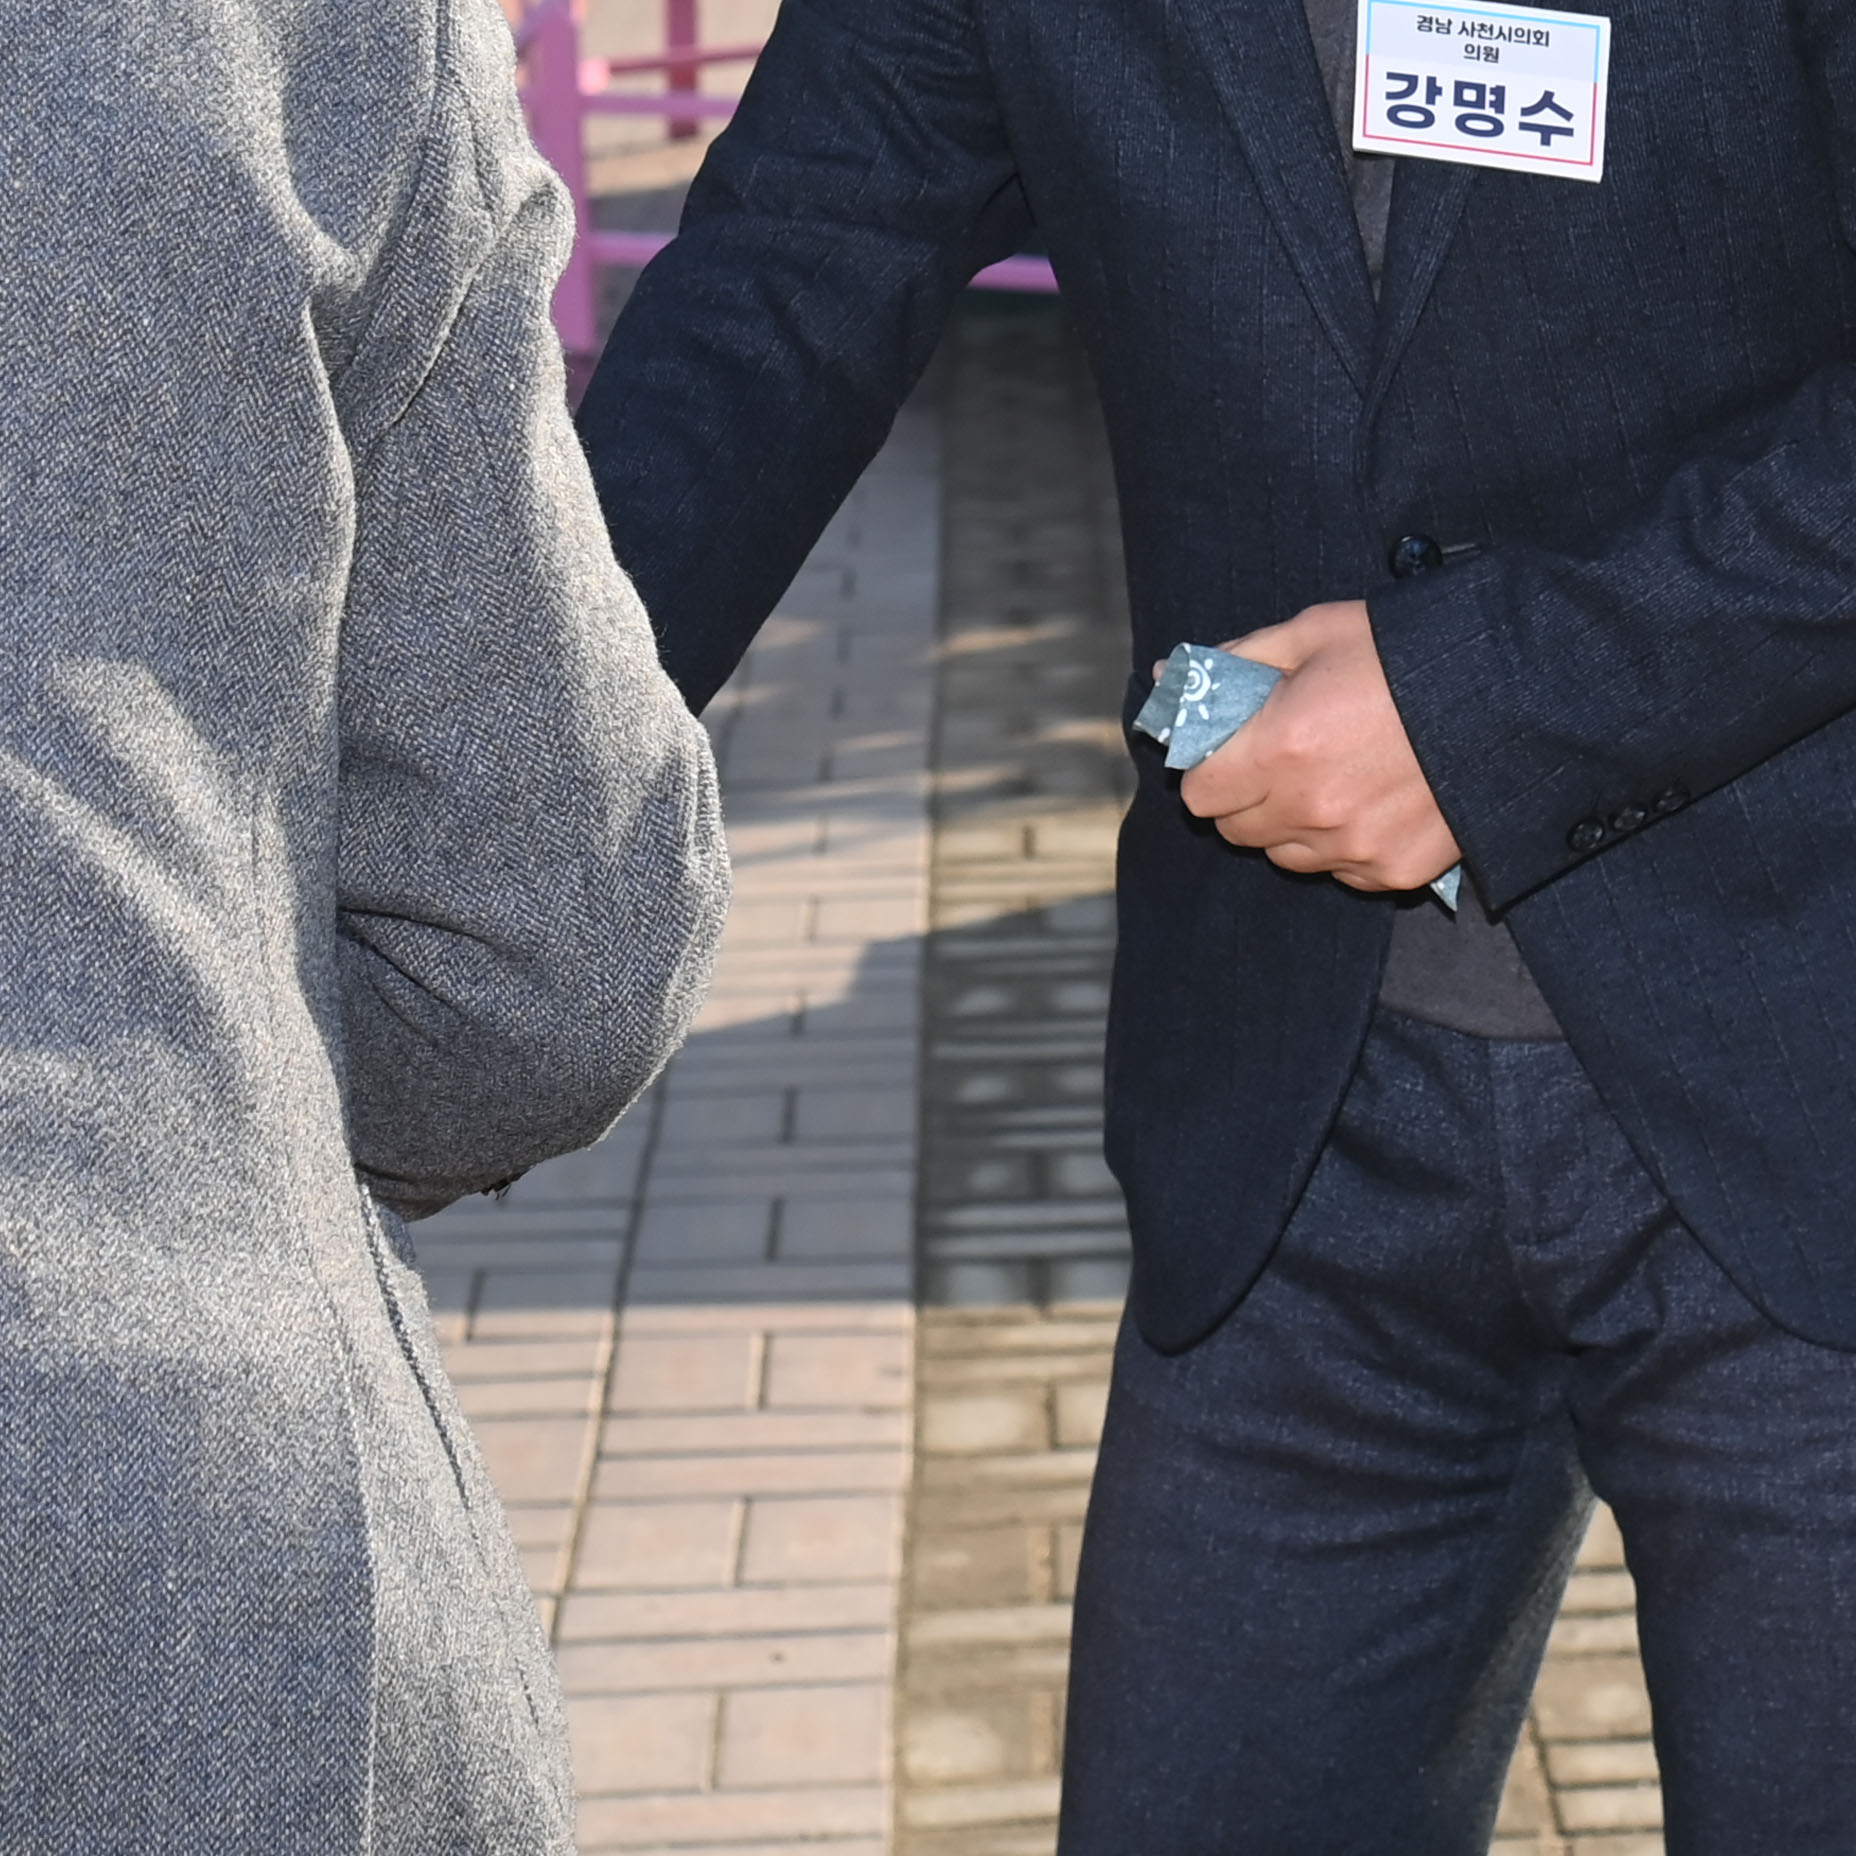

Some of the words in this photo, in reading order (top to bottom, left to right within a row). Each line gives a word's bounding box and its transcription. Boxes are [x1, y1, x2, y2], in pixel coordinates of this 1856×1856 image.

[1416, 14, 1453, 36] 경남
[1457, 19, 1550, 48] 사천시의회
[1463, 42, 1500, 64] 의원
[1384, 70, 1575, 147] 강명수
